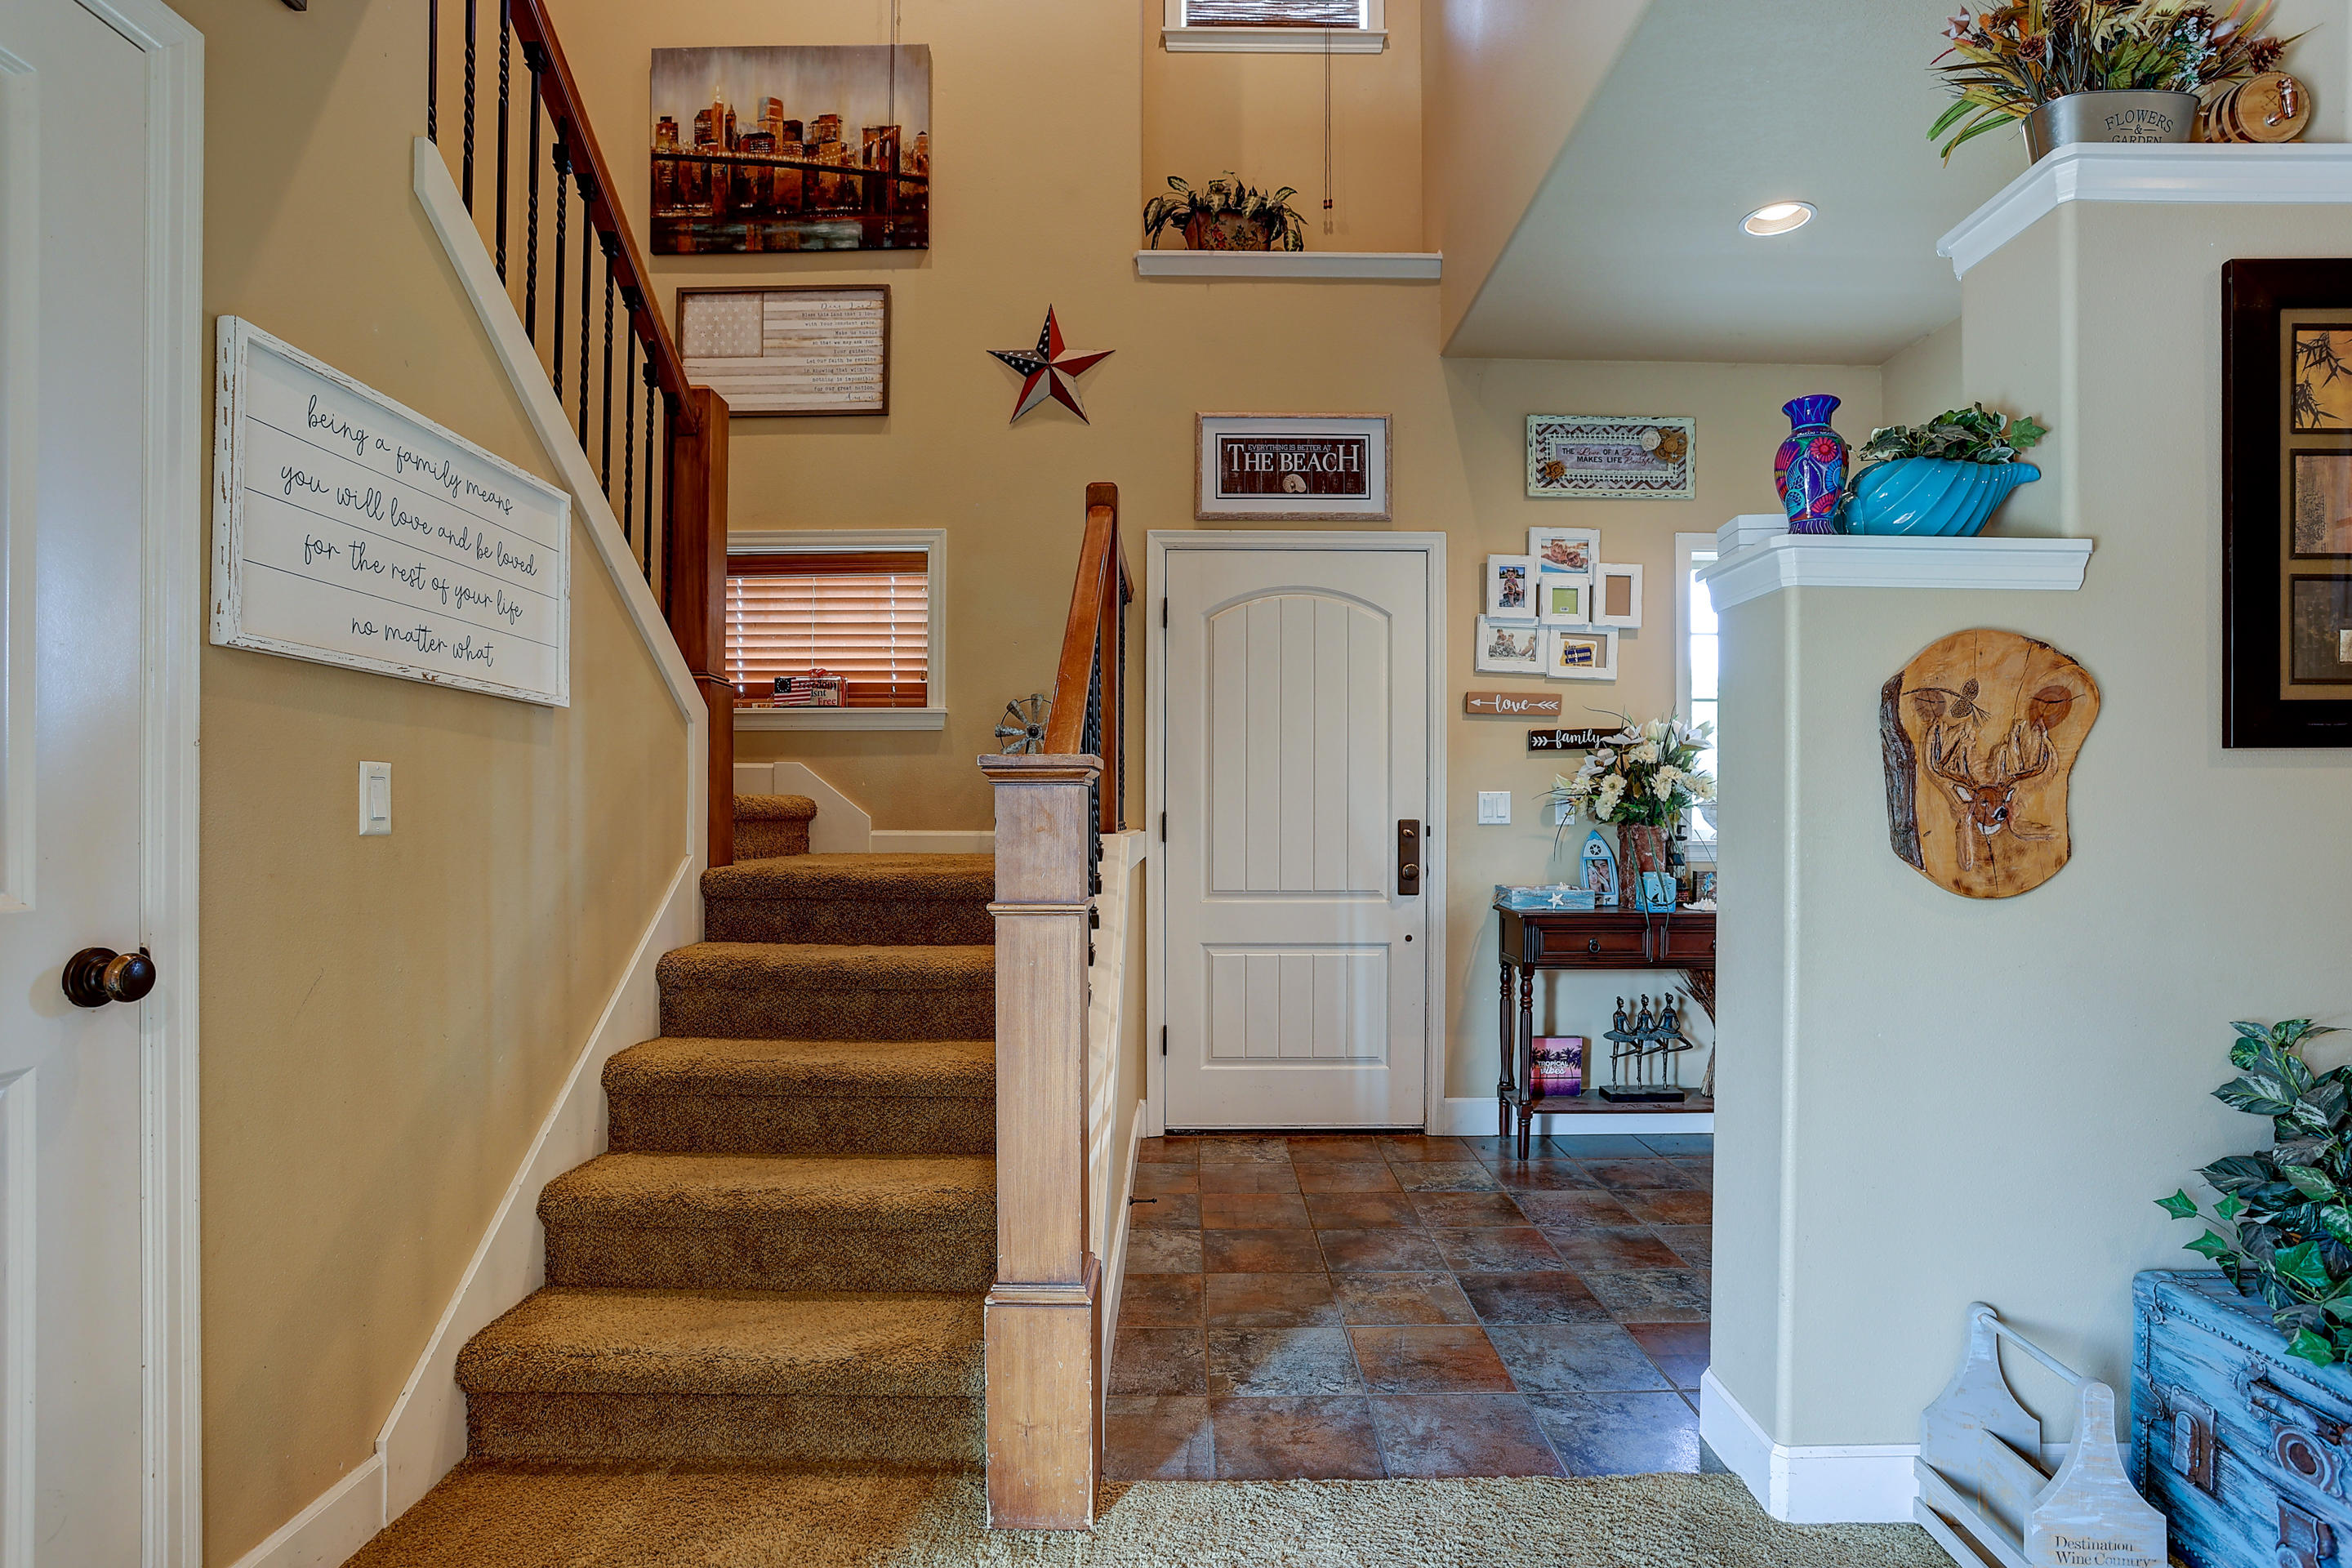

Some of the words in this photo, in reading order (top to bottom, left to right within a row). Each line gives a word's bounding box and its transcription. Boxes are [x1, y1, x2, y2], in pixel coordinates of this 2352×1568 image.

[2105, 109, 2173, 133] FLOWERS
[2134, 124, 2143, 135] &
[307, 394, 369, 455] being
[376, 437, 391, 452] a
[396, 445, 462, 497] family
[466, 479, 514, 515] means
[1227, 443, 1274, 472] THE
[1279, 444, 1360, 472] BEACH
[1576, 447, 1599, 456] Love
[280, 463, 329, 493] you
[336, 487, 385, 521] will
[390, 497, 433, 535] love
[439, 526, 471, 552] and
[476, 532, 492, 559] be
[497, 541, 537, 577] loved
[304, 533, 340, 564] for
[349, 540, 385, 574] the
[391, 563, 426, 590] rest
[431, 577, 450, 604] of
[454, 585, 493, 610] your
[497, 591, 523, 625] life
[351, 617, 378, 636] no
[385, 622, 448, 653] matter
[452, 635, 494, 666] what
[799, 679, 837, 690] Freedom
[817, 697, 836, 706] Free
[1494, 694, 1530, 713] love
[1556, 729, 1601, 749] family
[1540, 1066, 1566, 1075] vibes
[2055, 1535, 2134, 1552] Destination
[2055, 1551, 2092, 1565] Wine
